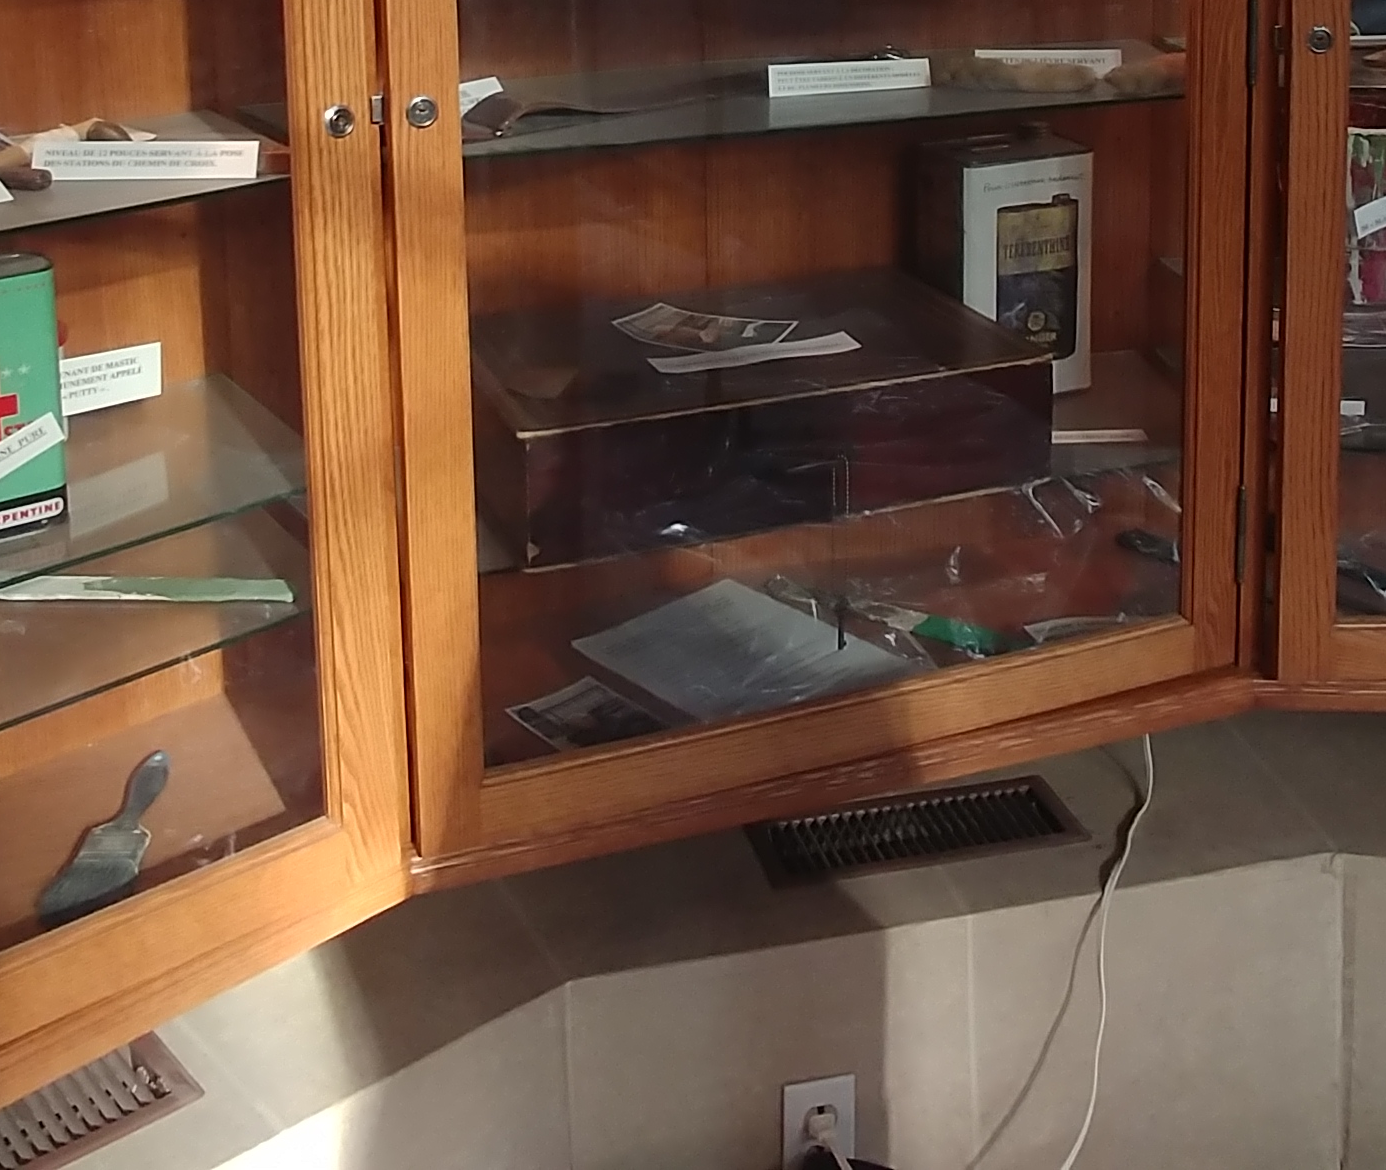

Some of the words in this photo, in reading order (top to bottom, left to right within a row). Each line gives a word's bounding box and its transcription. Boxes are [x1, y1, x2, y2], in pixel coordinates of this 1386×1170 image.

[91, 364, 104, 372] DE
[106, 357, 138, 370] MASTIC
[18, 426, 46, 450] PURE
